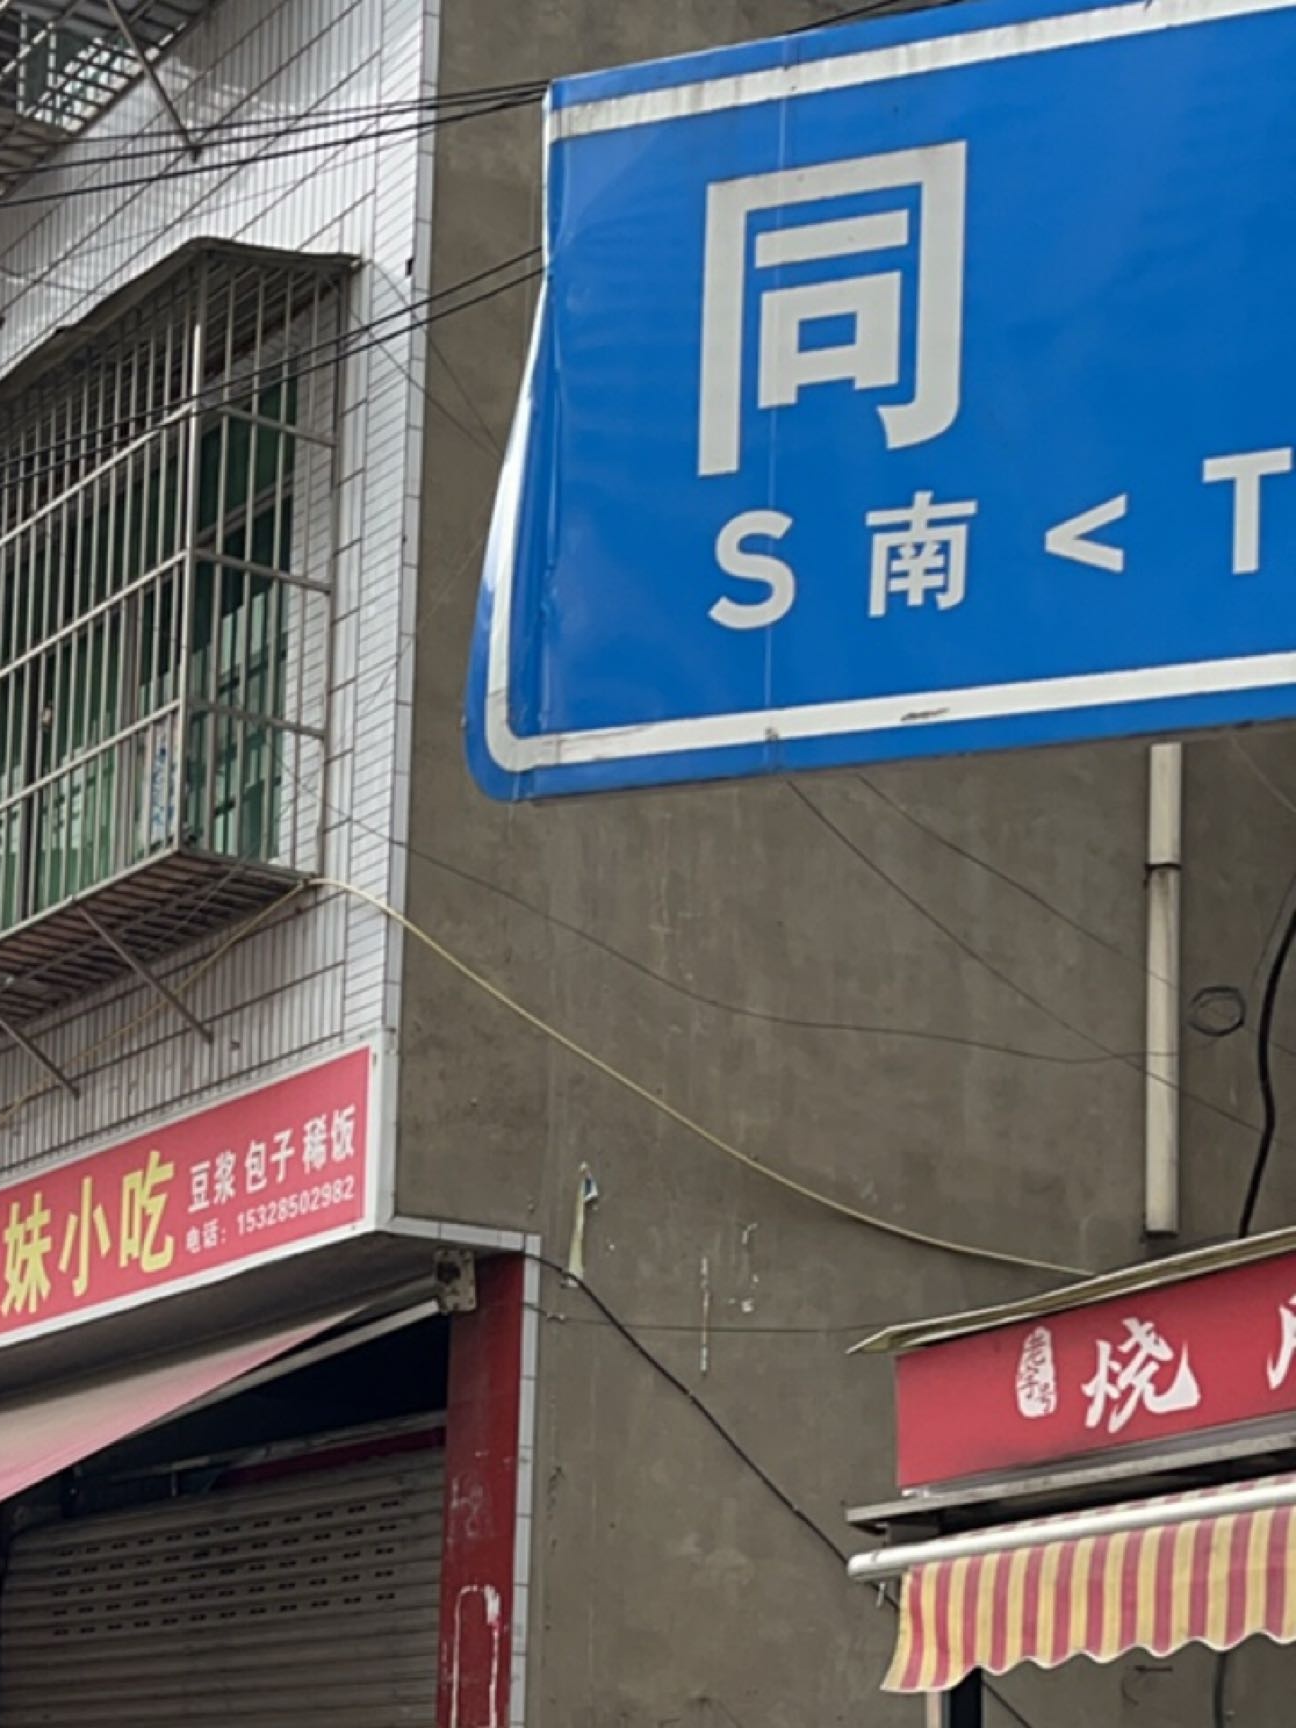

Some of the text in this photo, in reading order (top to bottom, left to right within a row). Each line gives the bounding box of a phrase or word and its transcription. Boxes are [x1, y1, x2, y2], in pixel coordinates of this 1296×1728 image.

[698, 139, 968, 478] 同
[708, 510, 796, 630] S
[865, 490, 978, 619] 南
[187, 1103, 356, 1215] 豆浆 包子 稀饭
[236, 1174, 355, 1236] 15328502982
